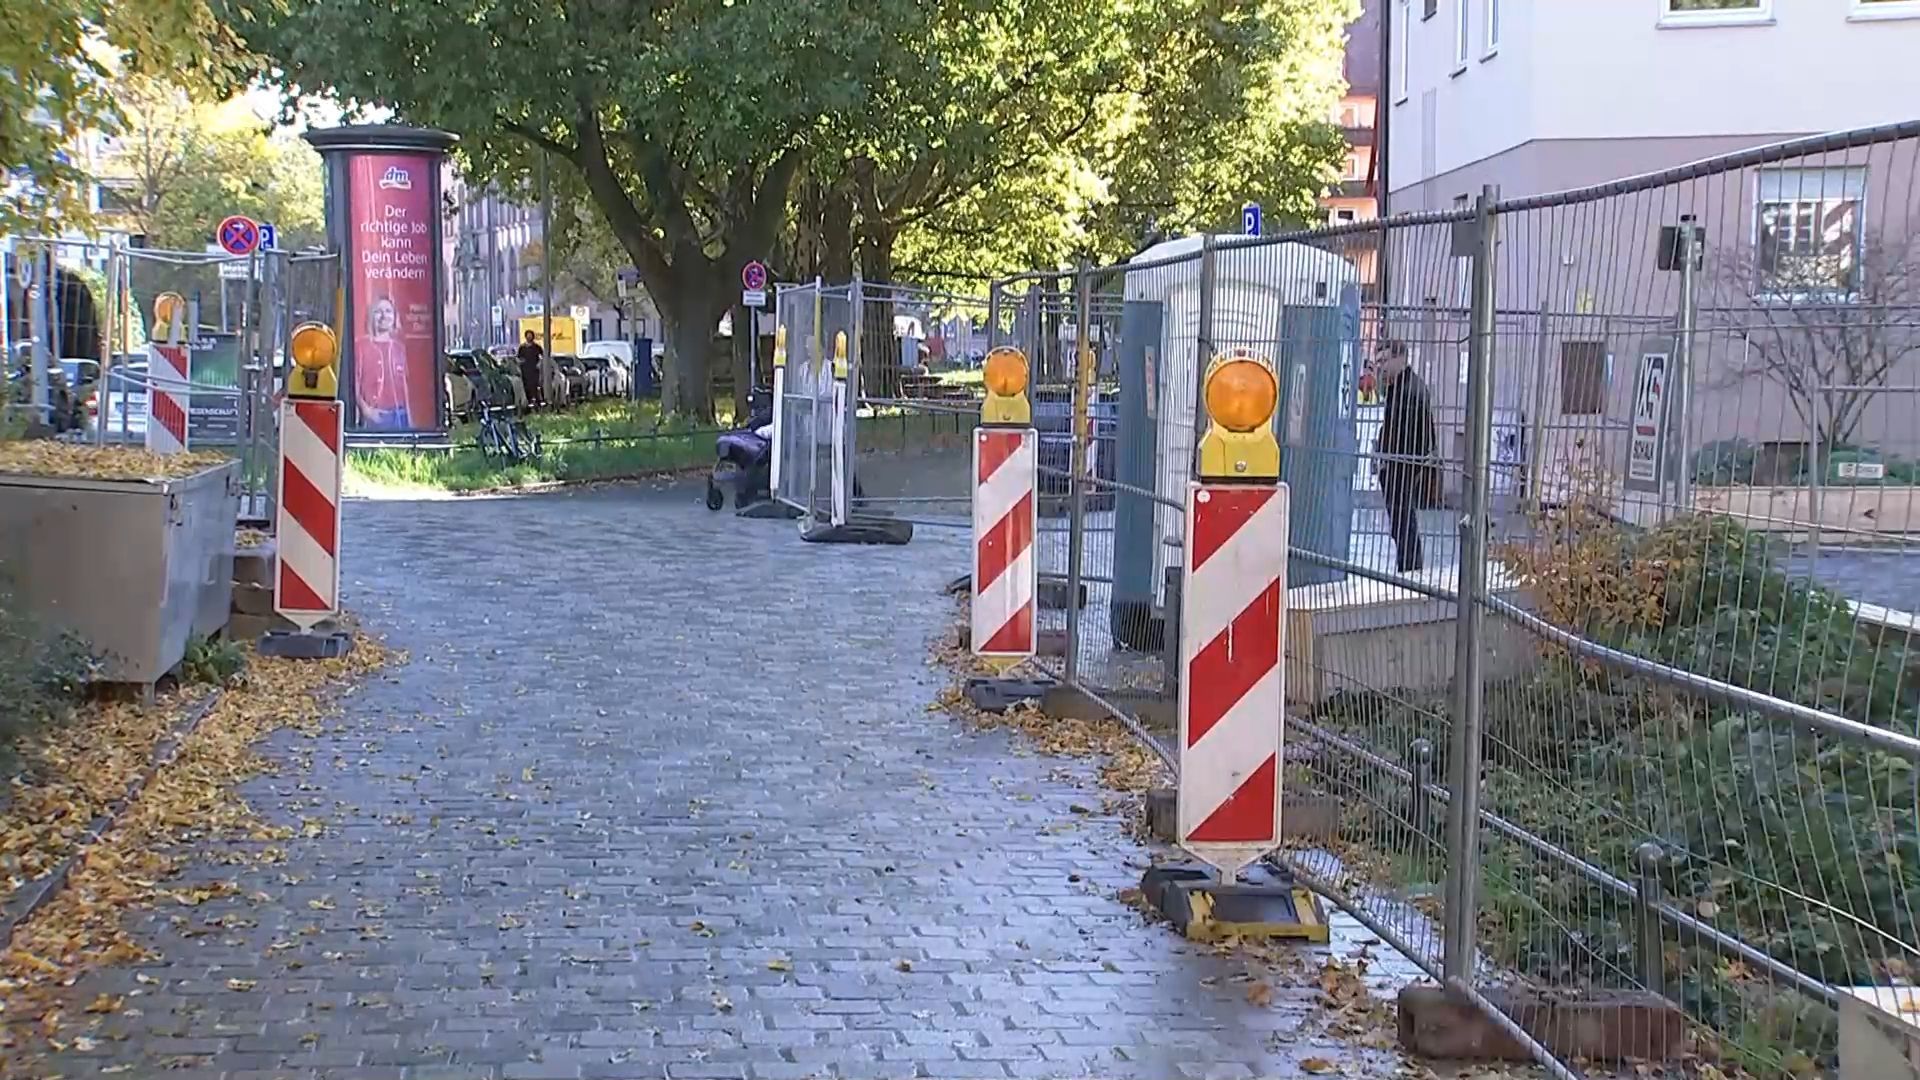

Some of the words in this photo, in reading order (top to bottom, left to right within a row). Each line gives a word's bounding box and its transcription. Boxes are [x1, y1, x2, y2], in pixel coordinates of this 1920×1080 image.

[386, 167, 407, 181] dm
[385, 204, 407, 217] Der
[361, 219, 408, 235] richtige
[411, 220, 427, 233] Job
[1245, 212, 1255, 235] P
[260, 228, 270, 250] P
[381, 235, 412, 248] kann
[362, 250, 391, 263] Dein
[395, 251, 427, 264] Leben
[365, 266, 425, 279] verändern
